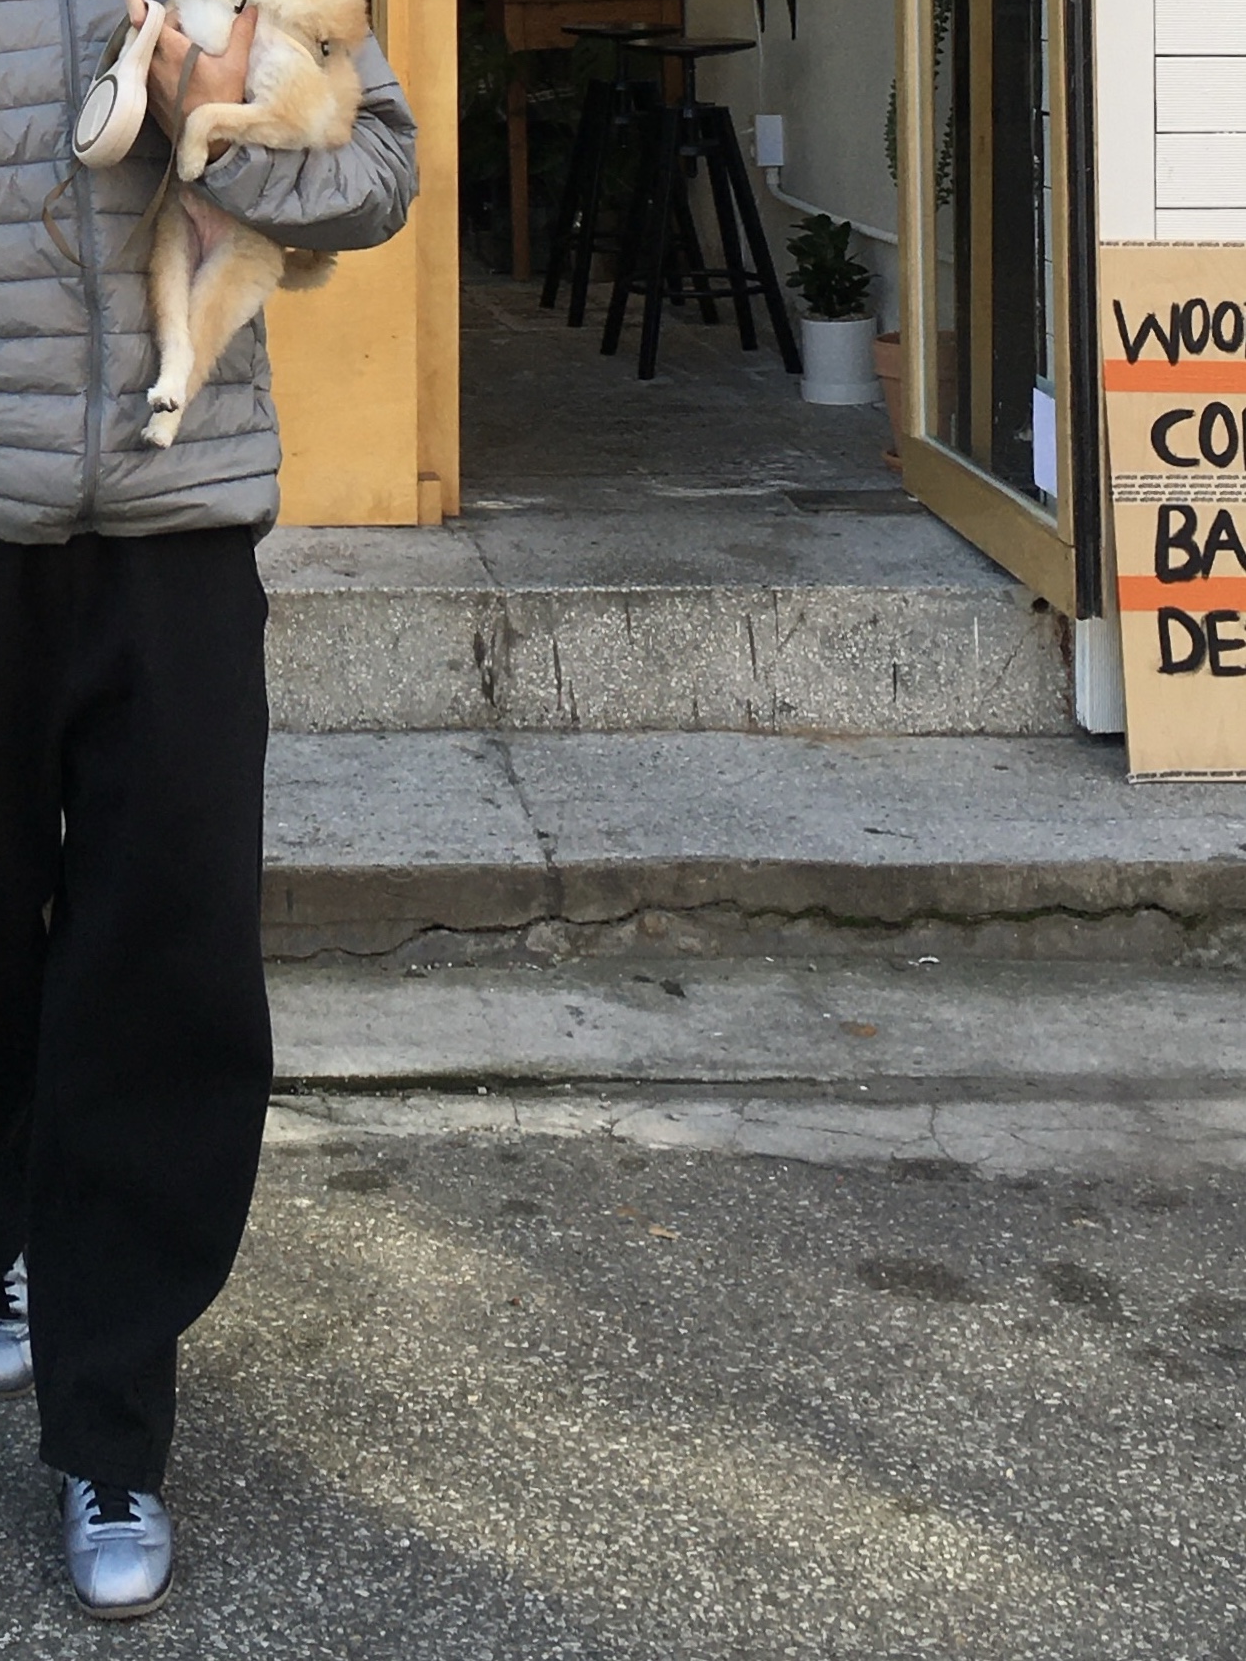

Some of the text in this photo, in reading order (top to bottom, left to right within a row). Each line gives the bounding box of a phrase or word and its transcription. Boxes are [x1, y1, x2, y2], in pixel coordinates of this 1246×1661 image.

[1113, 297, 1246, 366] WOO
[1151, 401, 1246, 470] CO
[1157, 606, 1246, 677] DE
